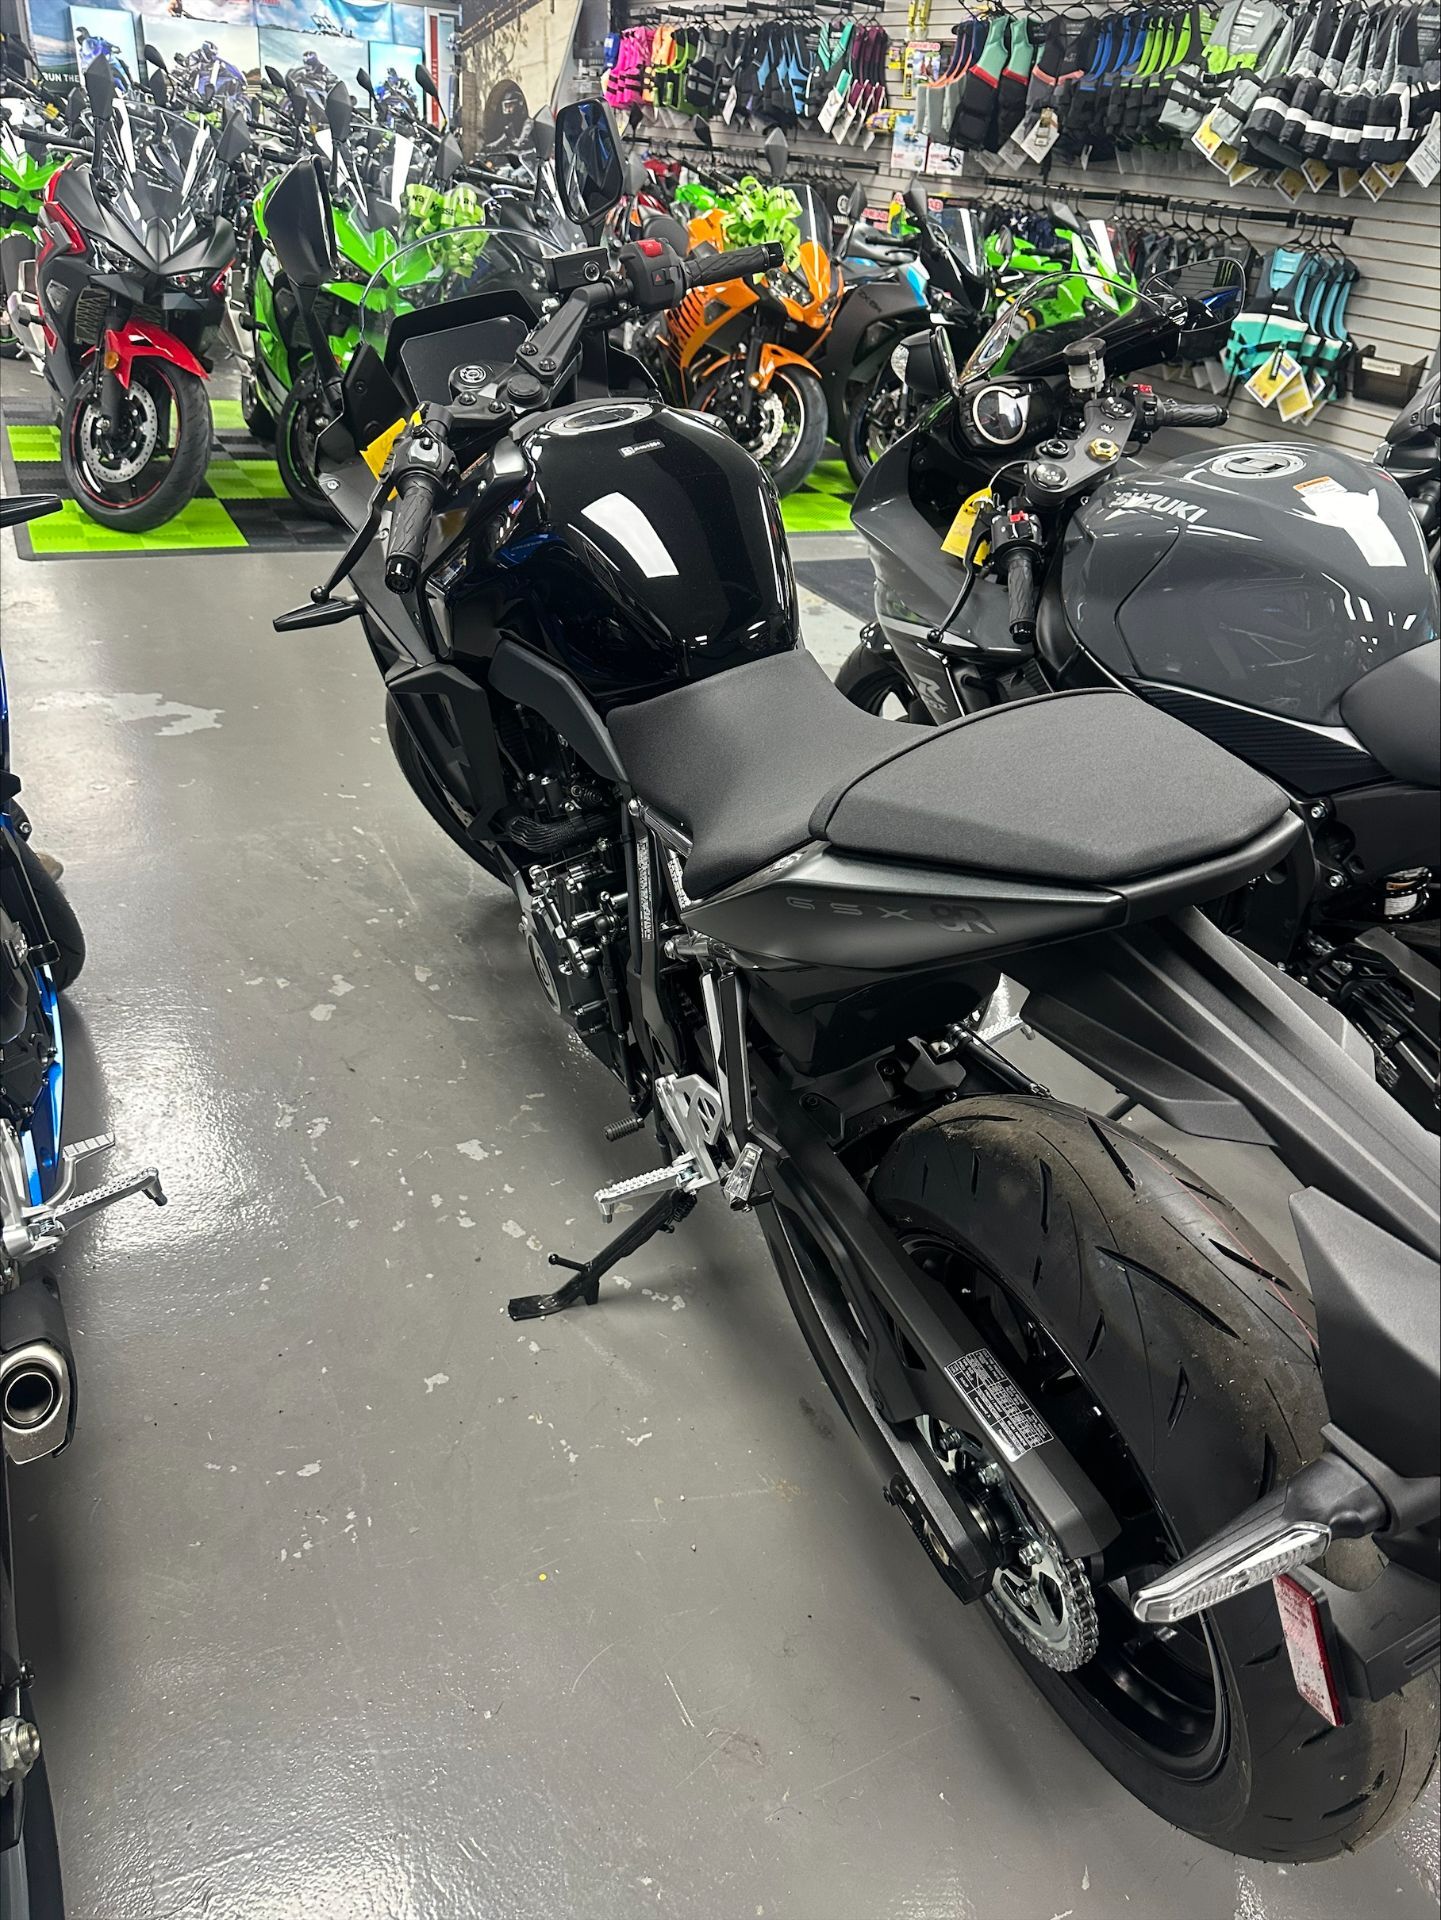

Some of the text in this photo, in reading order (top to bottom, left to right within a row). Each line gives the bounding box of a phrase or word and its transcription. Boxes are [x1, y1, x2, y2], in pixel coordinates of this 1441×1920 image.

[42, 71, 80, 83] RUN THE
[1110, 492, 1208, 523] SUZUKI
